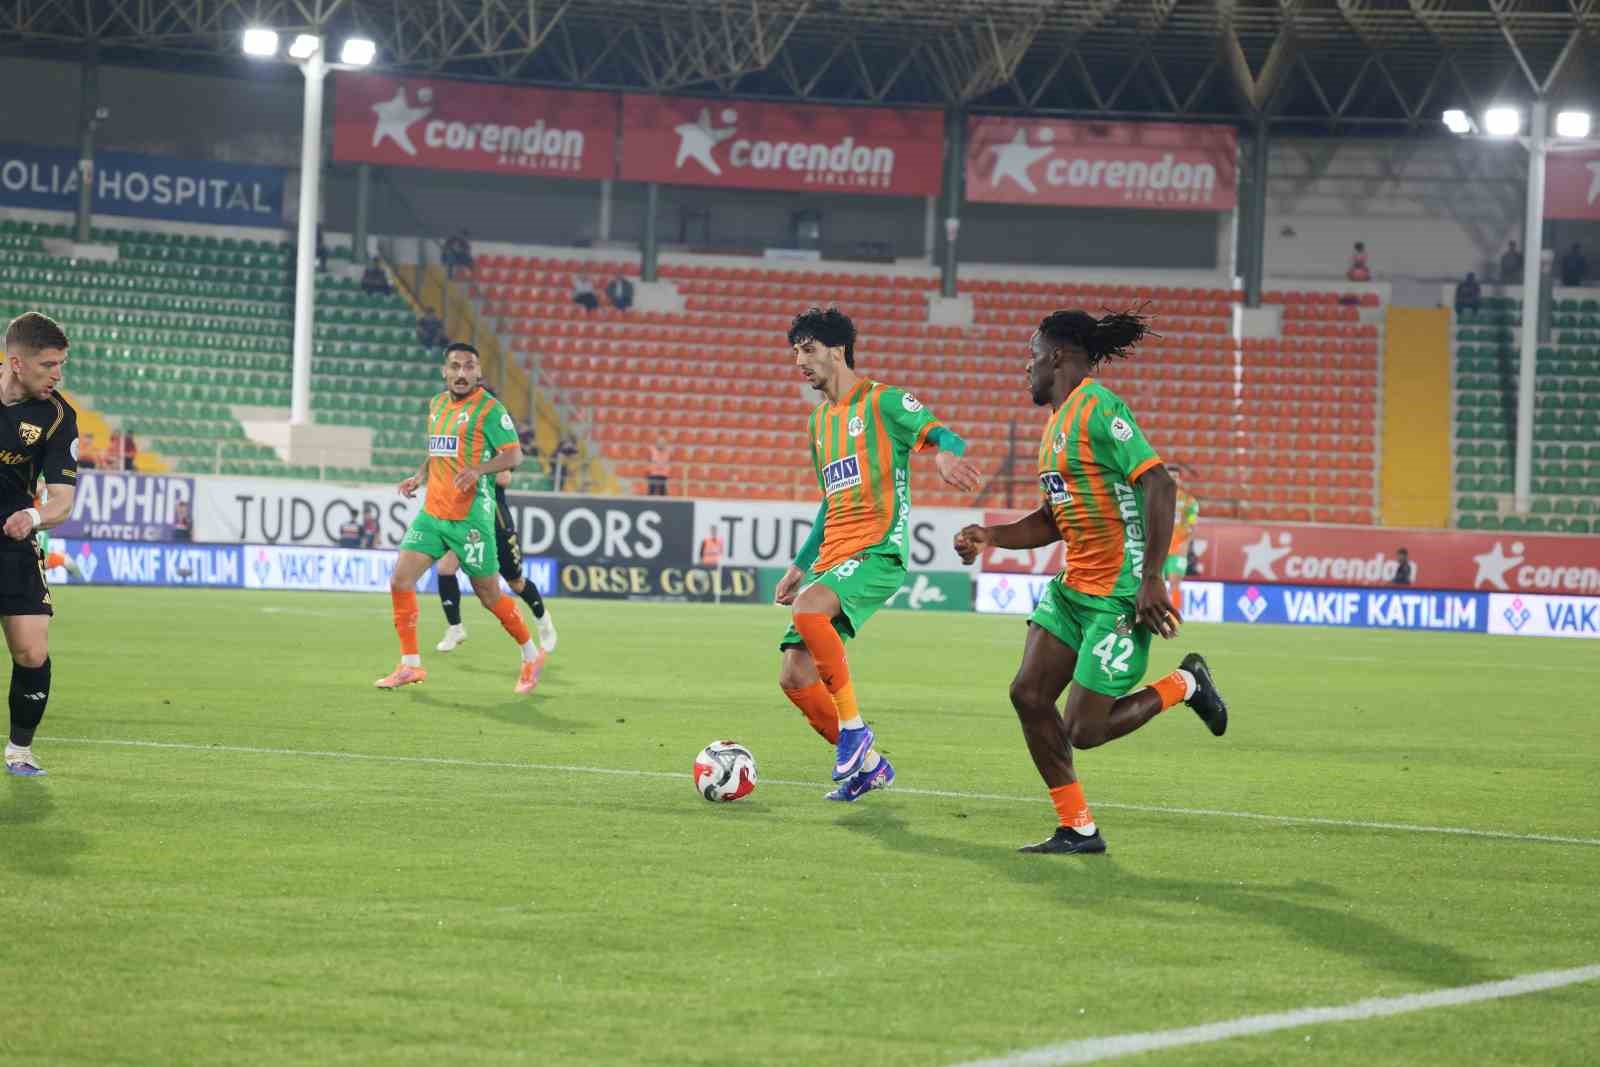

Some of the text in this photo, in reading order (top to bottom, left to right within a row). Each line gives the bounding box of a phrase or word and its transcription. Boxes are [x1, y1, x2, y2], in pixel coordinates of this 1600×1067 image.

[424, 119, 584, 158] corendon
[730, 137, 895, 174] corendon
[498, 155, 582, 171] AIRLINES
[804, 172, 891, 188] AIRLINES
[1047, 153, 1217, 190] corendon
[99, 170, 271, 213] HOSPITAL
[509, 505, 663, 558] DORS
[720, 515, 936, 566] TUDS
[106, 546, 238, 584] VAKIF KATILIM
[278, 552, 325, 584] VAKIF
[464, 542, 485, 564] 27
[561, 564, 650, 593] ORSE
[660, 567, 755, 597] GOLD
[1283, 591, 1476, 628] VAKIF KATILIM
[1092, 633, 1134, 672] 42
